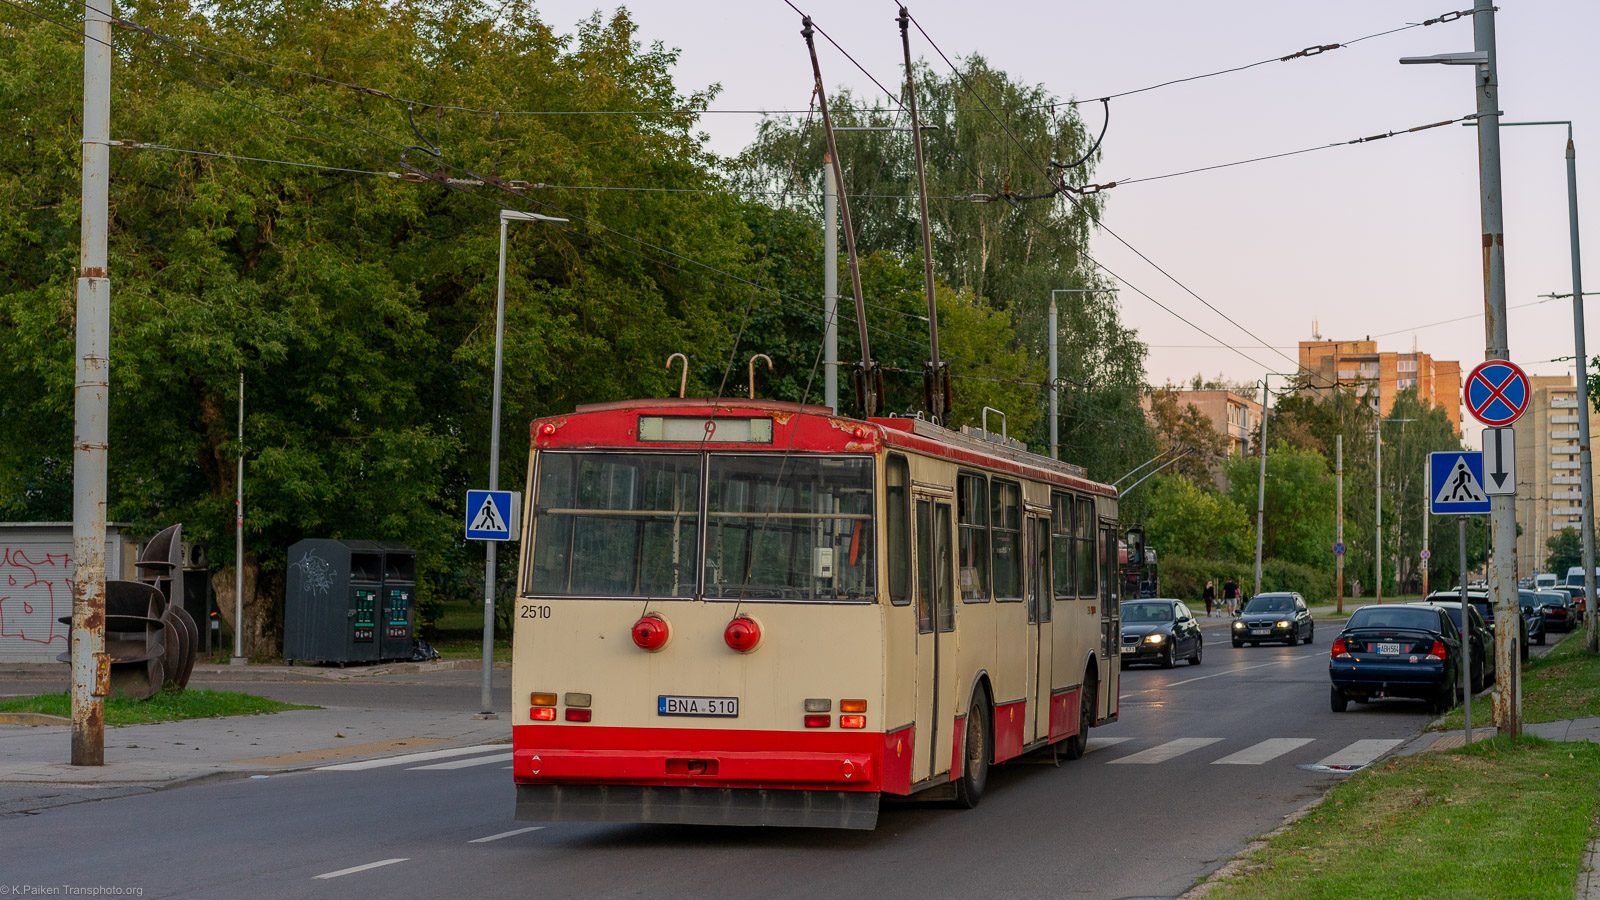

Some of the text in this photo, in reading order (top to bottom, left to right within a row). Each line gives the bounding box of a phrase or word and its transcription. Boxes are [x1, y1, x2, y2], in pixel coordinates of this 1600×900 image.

[704, 421, 717, 441] 9
[521, 605, 551, 619] 2510
[668, 699, 735, 714] BNA 510
